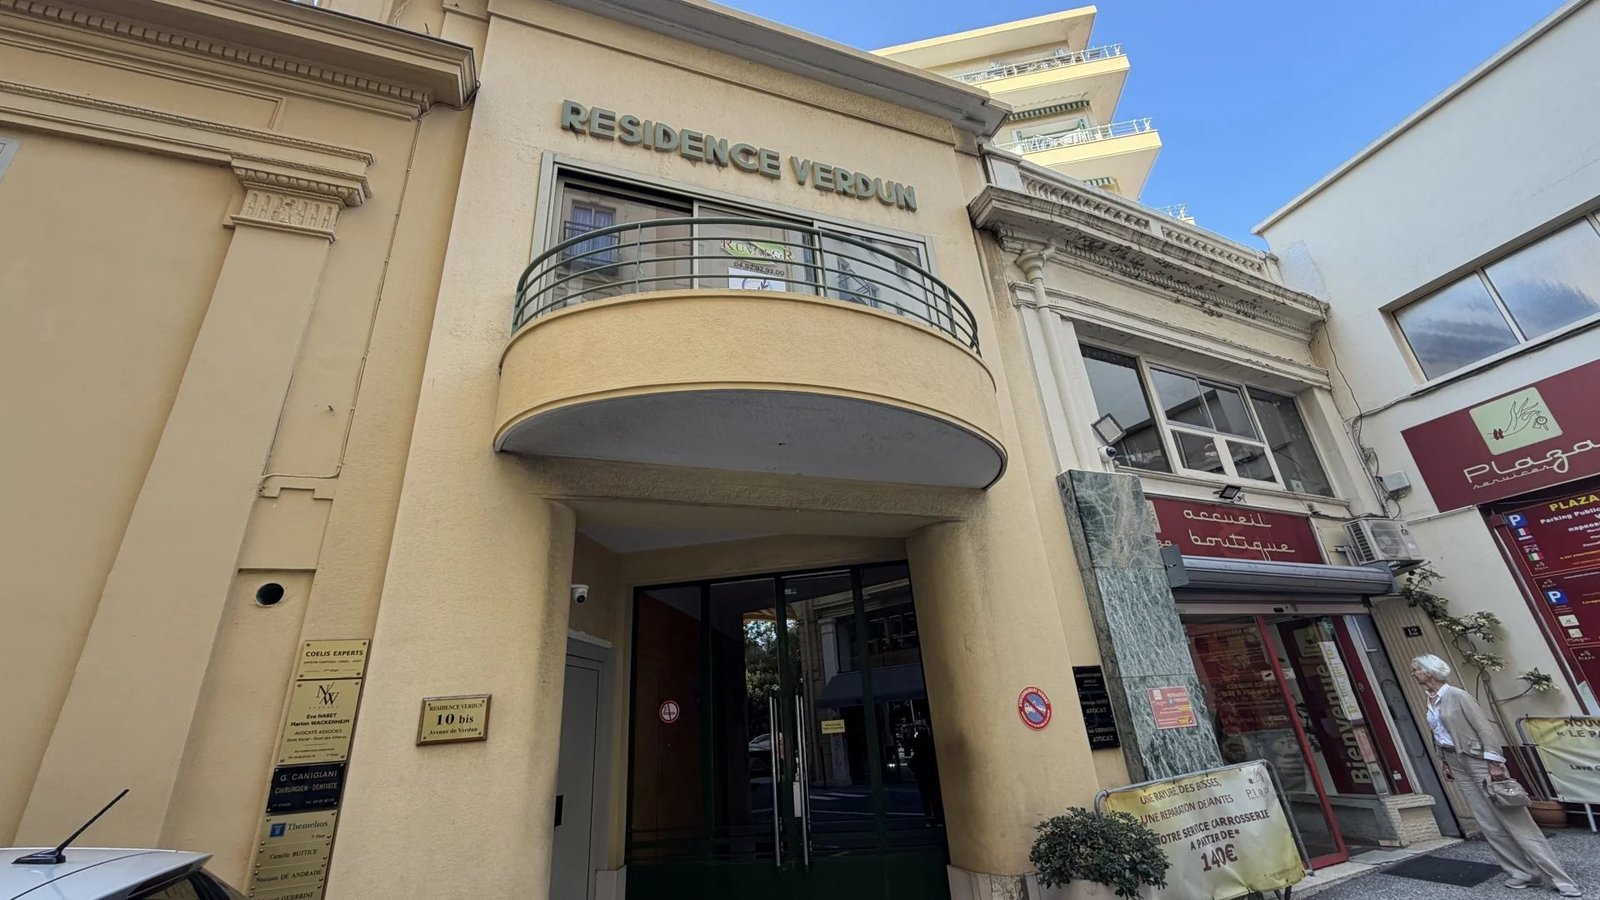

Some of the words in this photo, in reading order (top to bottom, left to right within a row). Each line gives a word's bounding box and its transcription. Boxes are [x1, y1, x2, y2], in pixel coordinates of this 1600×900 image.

[561, 99, 781, 179] RESIDENCE
[790, 155, 918, 212] VERDUN
[1463, 439, 1600, 484] Plaza
[1549, 494, 1600, 512] PLAZA
[1183, 507, 1271, 528] accueil
[1540, 512, 1573, 525] Parking
[1188, 529, 1295, 562] boutique
[1407, 627, 1419, 636] 12
[305, 650, 331, 658] COELIS
[332, 649, 364, 657] EXPERTS
[429, 703, 460, 712] RESIDENCE
[460, 702, 483, 710] VERDUN
[1086, 706, 1107, 714] AVOCAT
[436, 713, 455, 726] 10
[458, 714, 474, 724] bis
[429, 728, 449, 736] Avenue
[1568, 729, 1586, 738] LE
[1093, 735, 1114, 743] AVOCAT
[280, 774, 289, 782] G.
[291, 770, 338, 781] CANIGIANI
[274, 784, 309, 795] CHIRURGIEN
[312, 782, 337, 791] DENTISTE
[1178, 783, 1196, 794] DES
[1140, 814, 1160, 825] UNE
[1159, 800, 1196, 821] REPARATON
[1211, 809, 1270, 829] CARROSSERIE
[288, 820, 329, 831] Themelios
[1190, 841, 1197, 851] A
[1200, 843, 1239, 872] 140€
